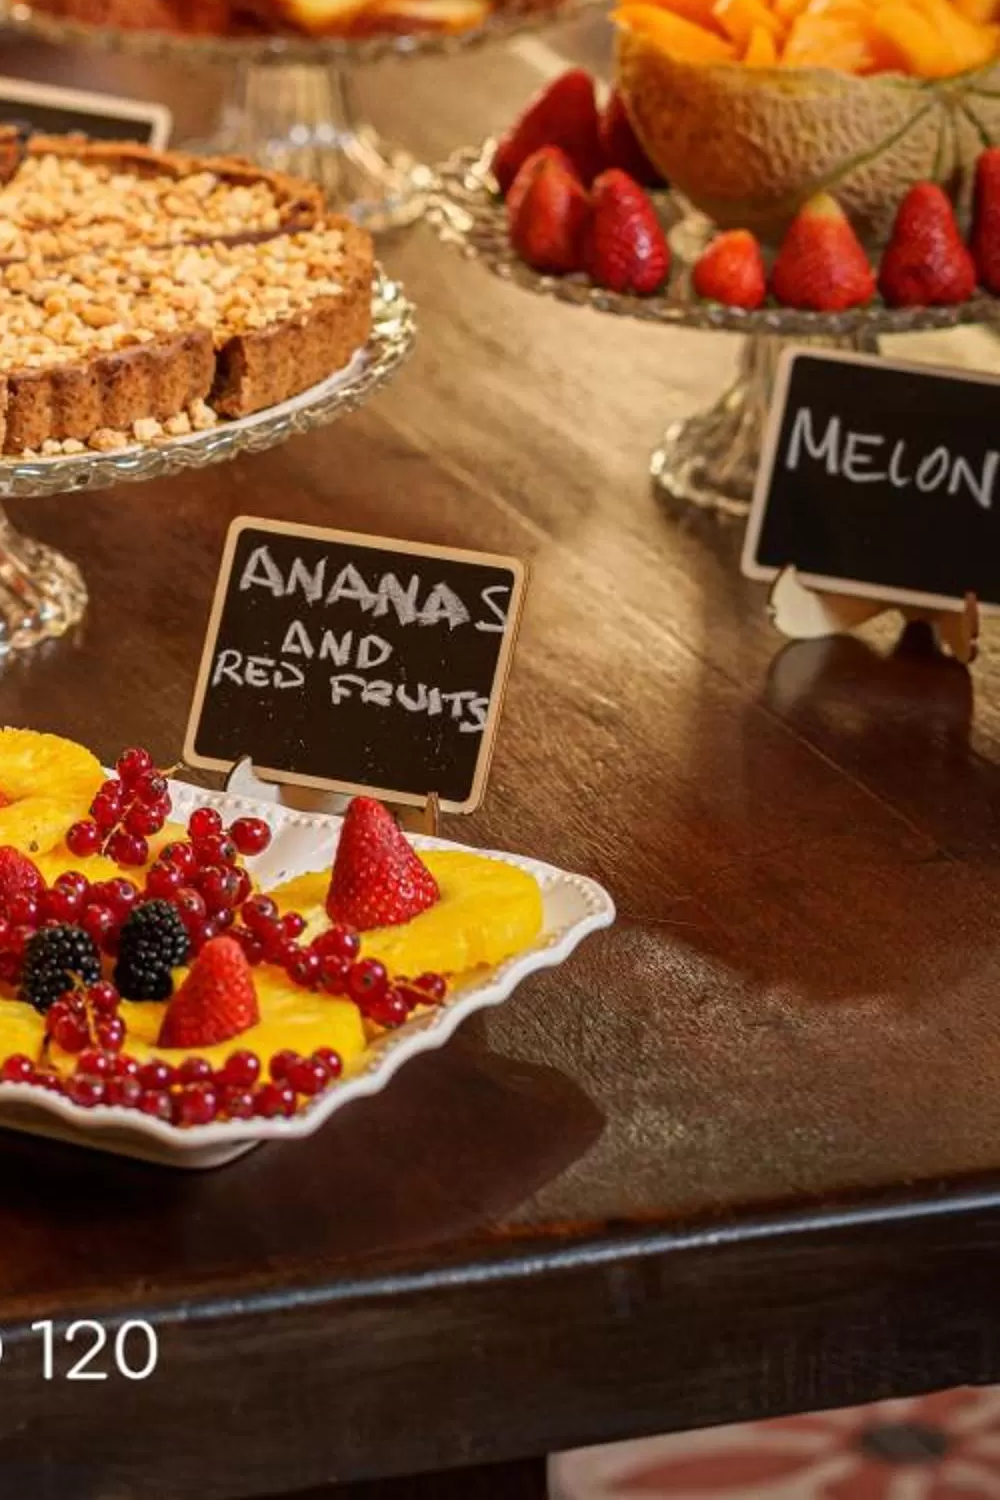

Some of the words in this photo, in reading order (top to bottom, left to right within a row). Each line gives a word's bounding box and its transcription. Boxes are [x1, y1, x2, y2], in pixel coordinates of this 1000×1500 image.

[786, 407, 1000, 509] MELON
[239, 545, 510, 633] ANANAS
[281, 620, 394, 669] AND
[212, 649, 305, 689] RED
[330, 674, 490, 733] FRUITS
